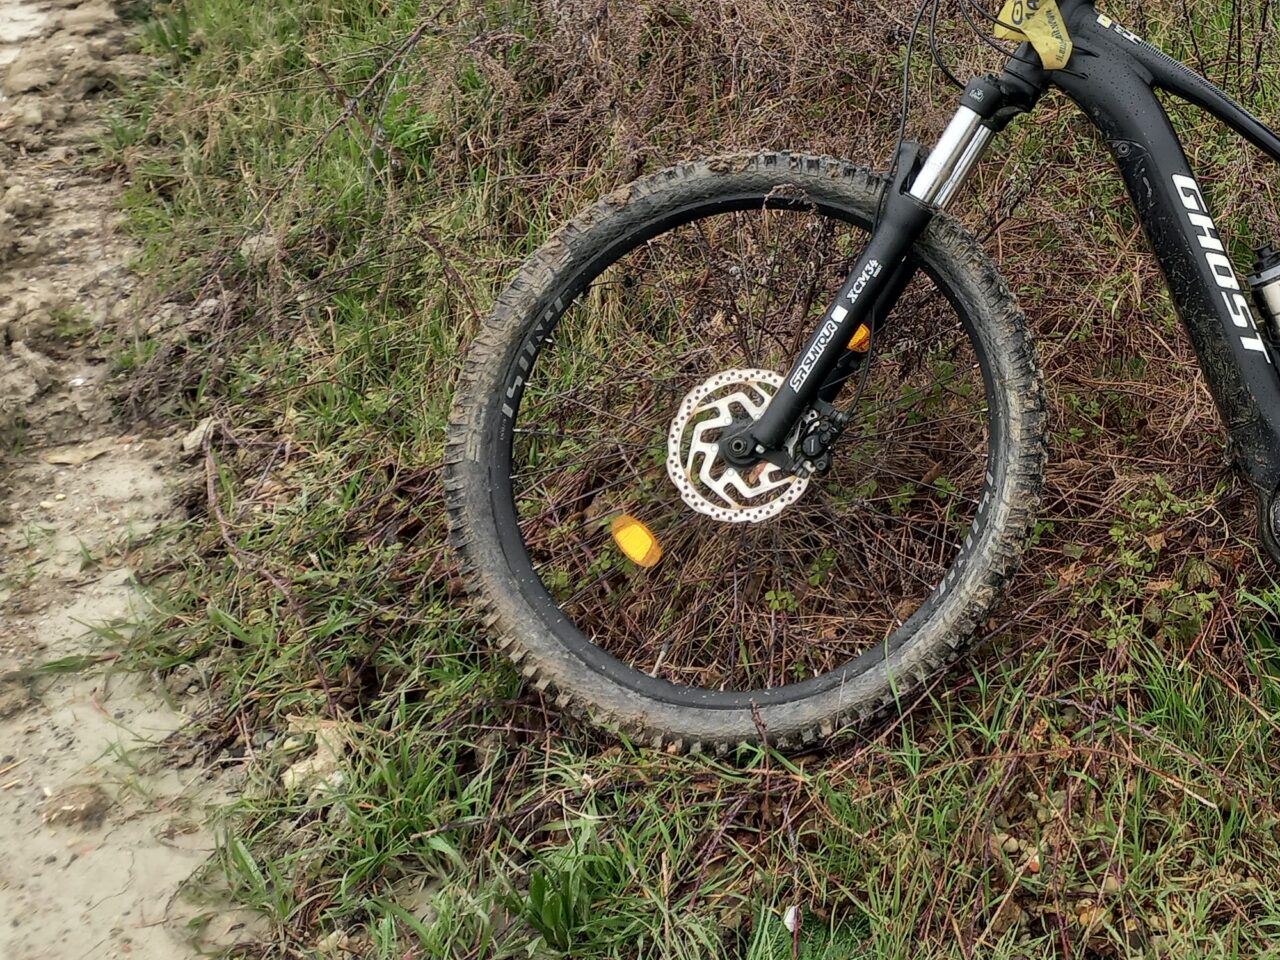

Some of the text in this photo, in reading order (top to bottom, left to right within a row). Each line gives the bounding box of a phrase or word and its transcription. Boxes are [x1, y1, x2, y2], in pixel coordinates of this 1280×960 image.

[847, 259, 878, 304] XCM34
[1171, 173, 1271, 365] GHOST
[802, 320, 838, 373] SUNTOUR
